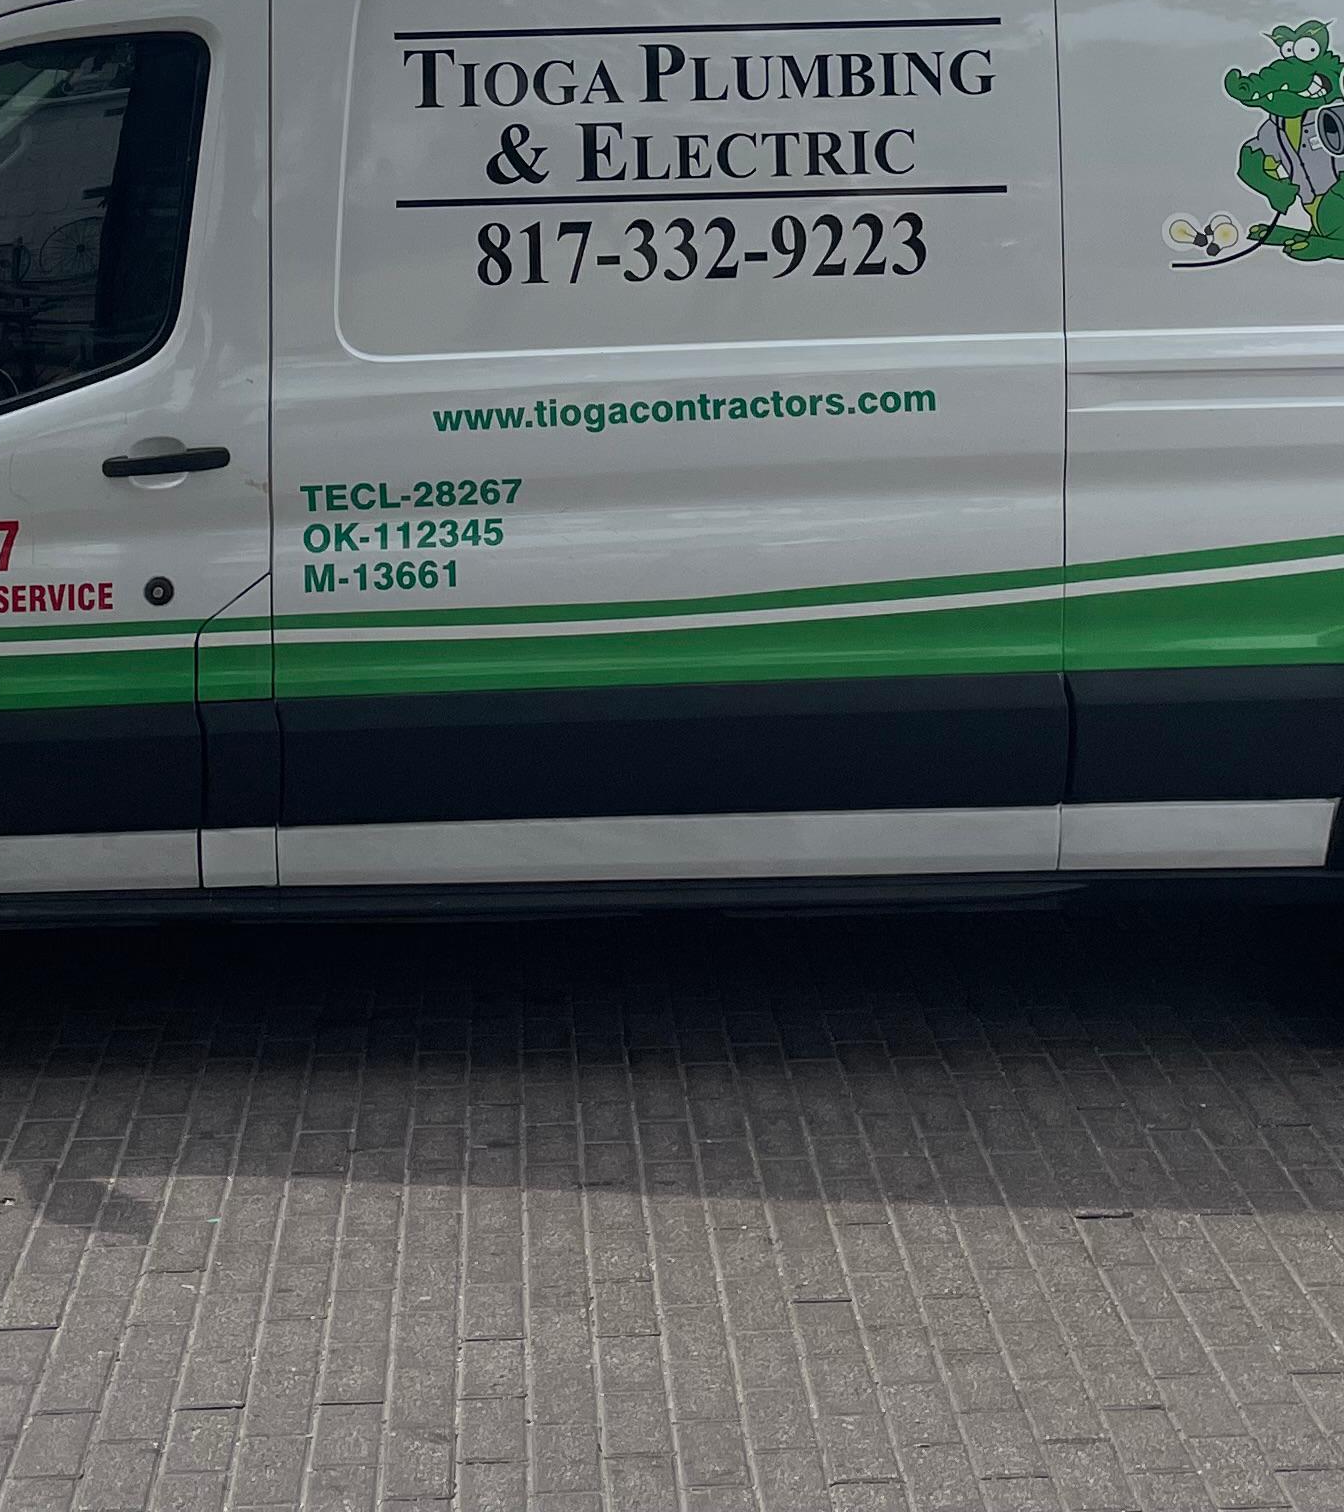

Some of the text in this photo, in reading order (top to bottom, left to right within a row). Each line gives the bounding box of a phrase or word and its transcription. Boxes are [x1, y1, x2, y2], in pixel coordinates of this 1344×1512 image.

[403, 43, 998, 109] TIOGA PLUMBING
[485, 121, 917, 186] & ELECTRIC
[477, 211, 928, 286] 817-332-9223
[432, 389, 937, 433] www.tiogacontractors.com
[299, 478, 523, 512] TECL-28267
[303, 518, 504, 554] OK-112345
[304, 560, 457, 593] M-13661
